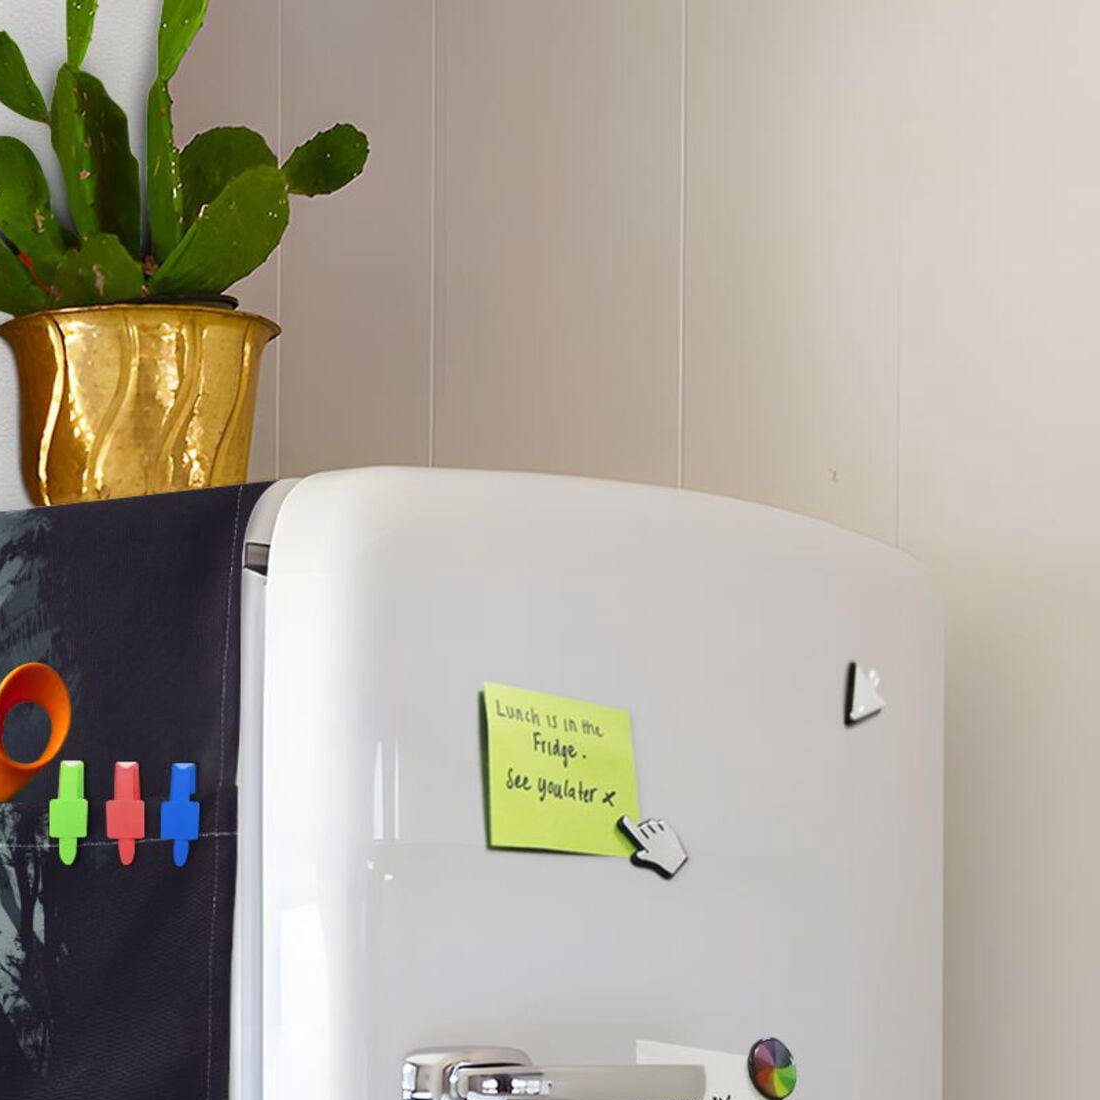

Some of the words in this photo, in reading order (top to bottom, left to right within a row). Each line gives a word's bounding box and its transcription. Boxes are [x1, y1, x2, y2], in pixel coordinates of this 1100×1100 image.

[495, 699, 541, 727] Lunch
[546, 714, 558, 729] is
[563, 718, 578, 733] in
[581, 719, 604, 738] the
[506, 768, 532, 791] See
